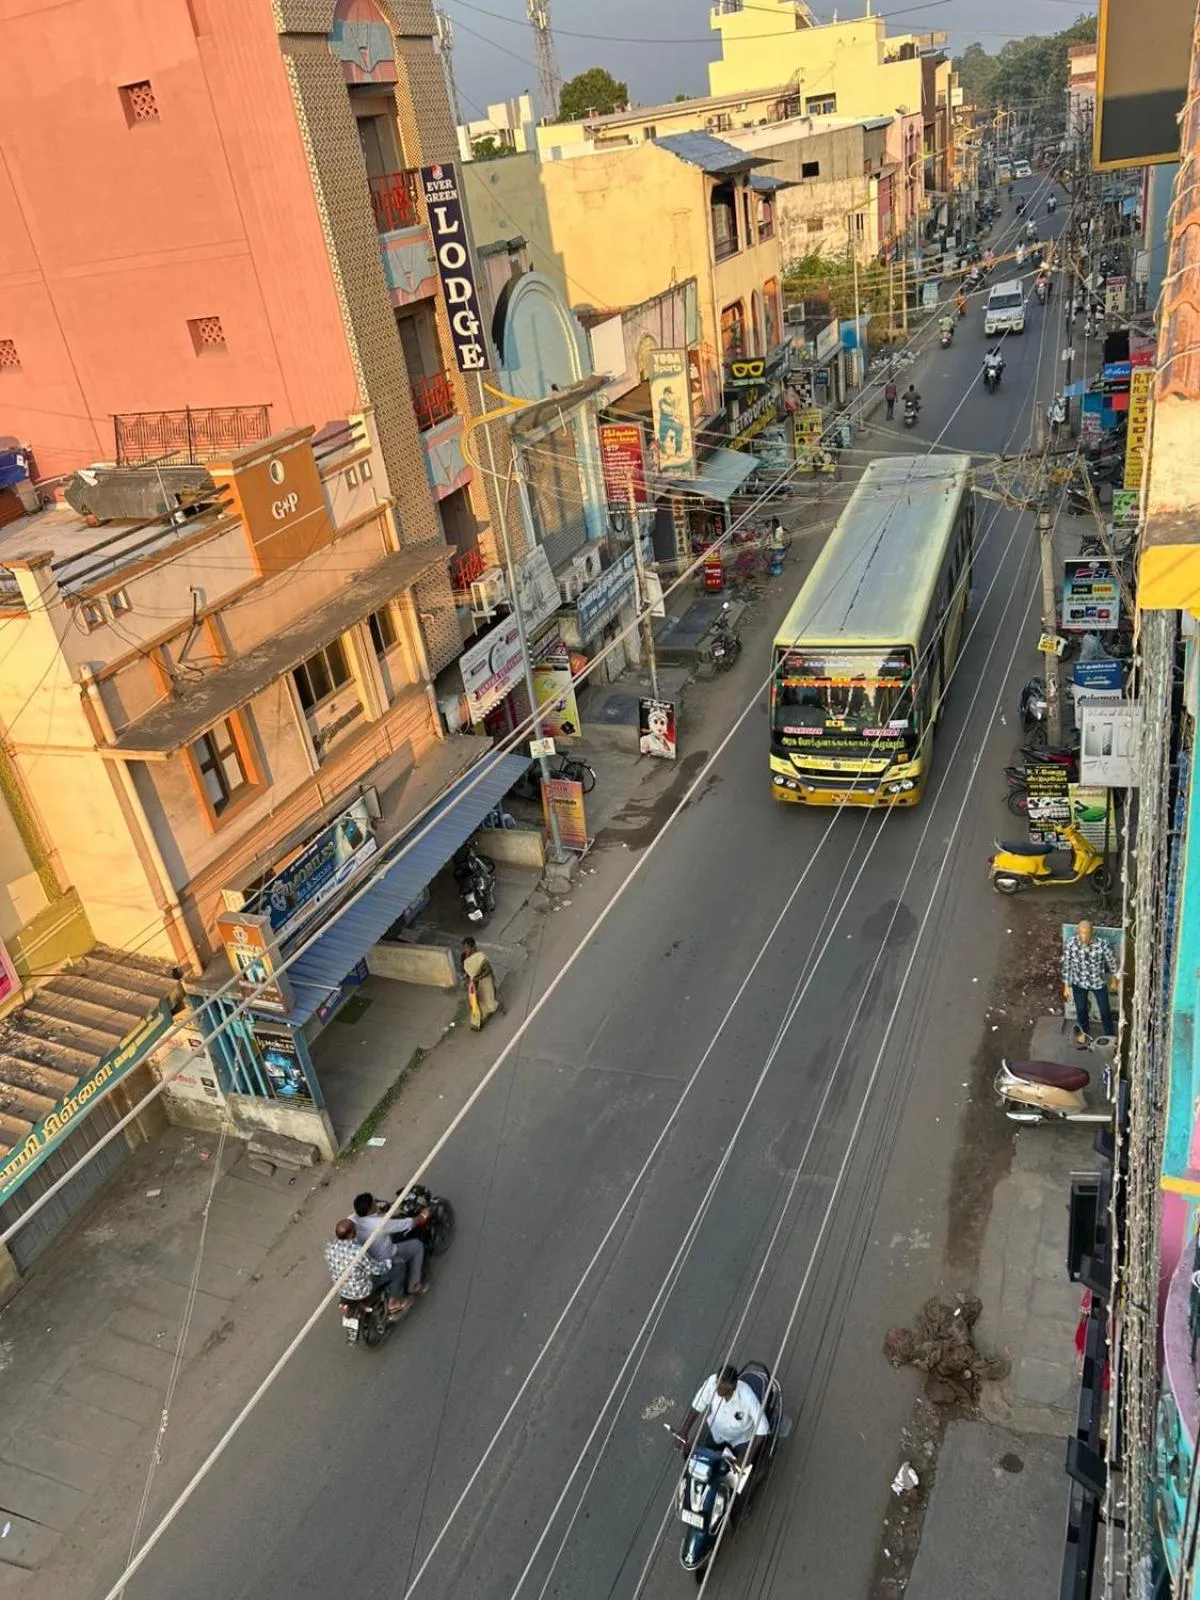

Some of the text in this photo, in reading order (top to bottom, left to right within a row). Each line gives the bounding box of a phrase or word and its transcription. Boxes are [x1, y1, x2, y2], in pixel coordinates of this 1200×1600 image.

[427, 179, 453, 192] EVER
[425, 189, 458, 203] GREEN
[433, 206, 485, 370] LODGE
